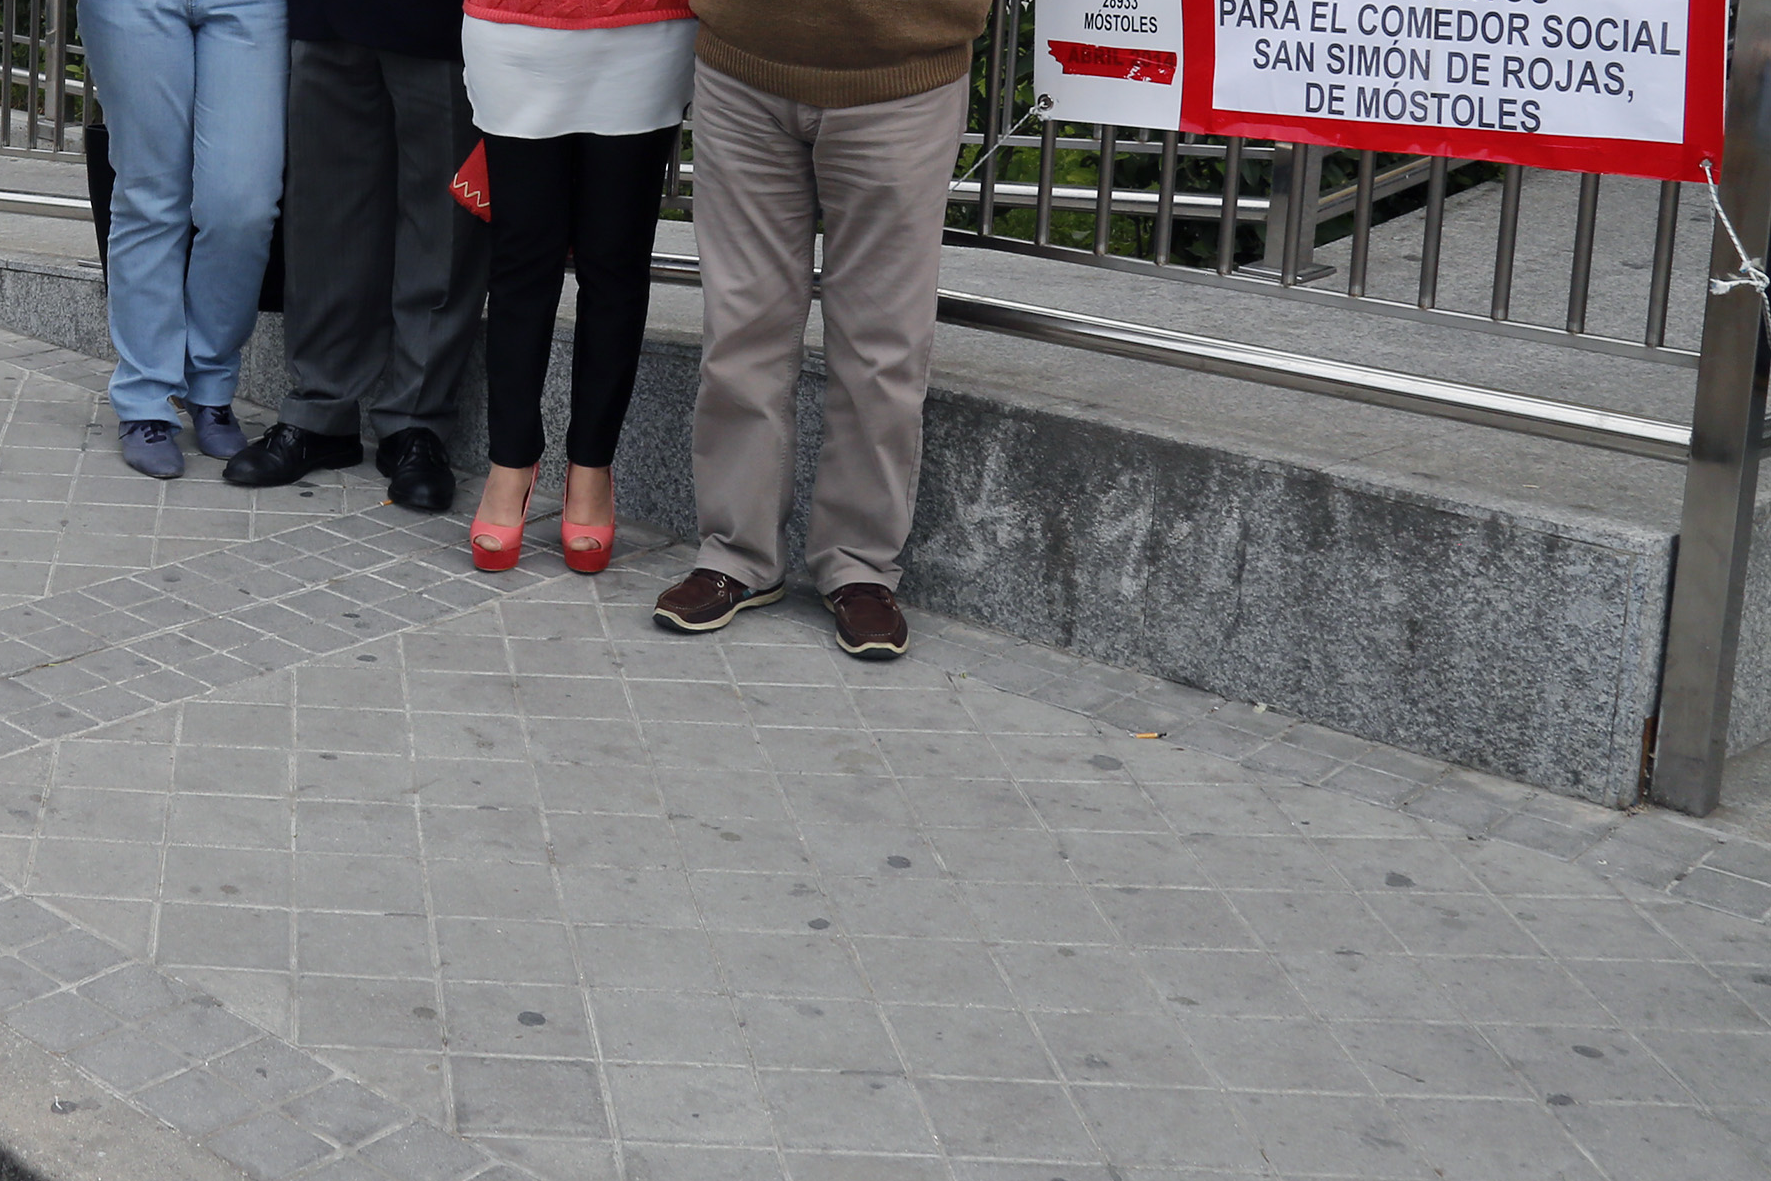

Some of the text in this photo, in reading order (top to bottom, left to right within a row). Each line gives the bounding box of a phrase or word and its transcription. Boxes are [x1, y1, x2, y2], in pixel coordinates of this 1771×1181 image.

[1084, 10, 1158, 33] MÓSTOLES
[1310, 2, 1347, 34] EL
[1357, 4, 1530, 46] COMEDOR
[1541, 15, 1681, 56] SOCIAL
[1067, 46, 1124, 66] ABRIL
[1253, 38, 1634, 103] SAN SIMÓN DE ROJAS,
[1305, 82, 1541, 133] DE MÓSTOLES
